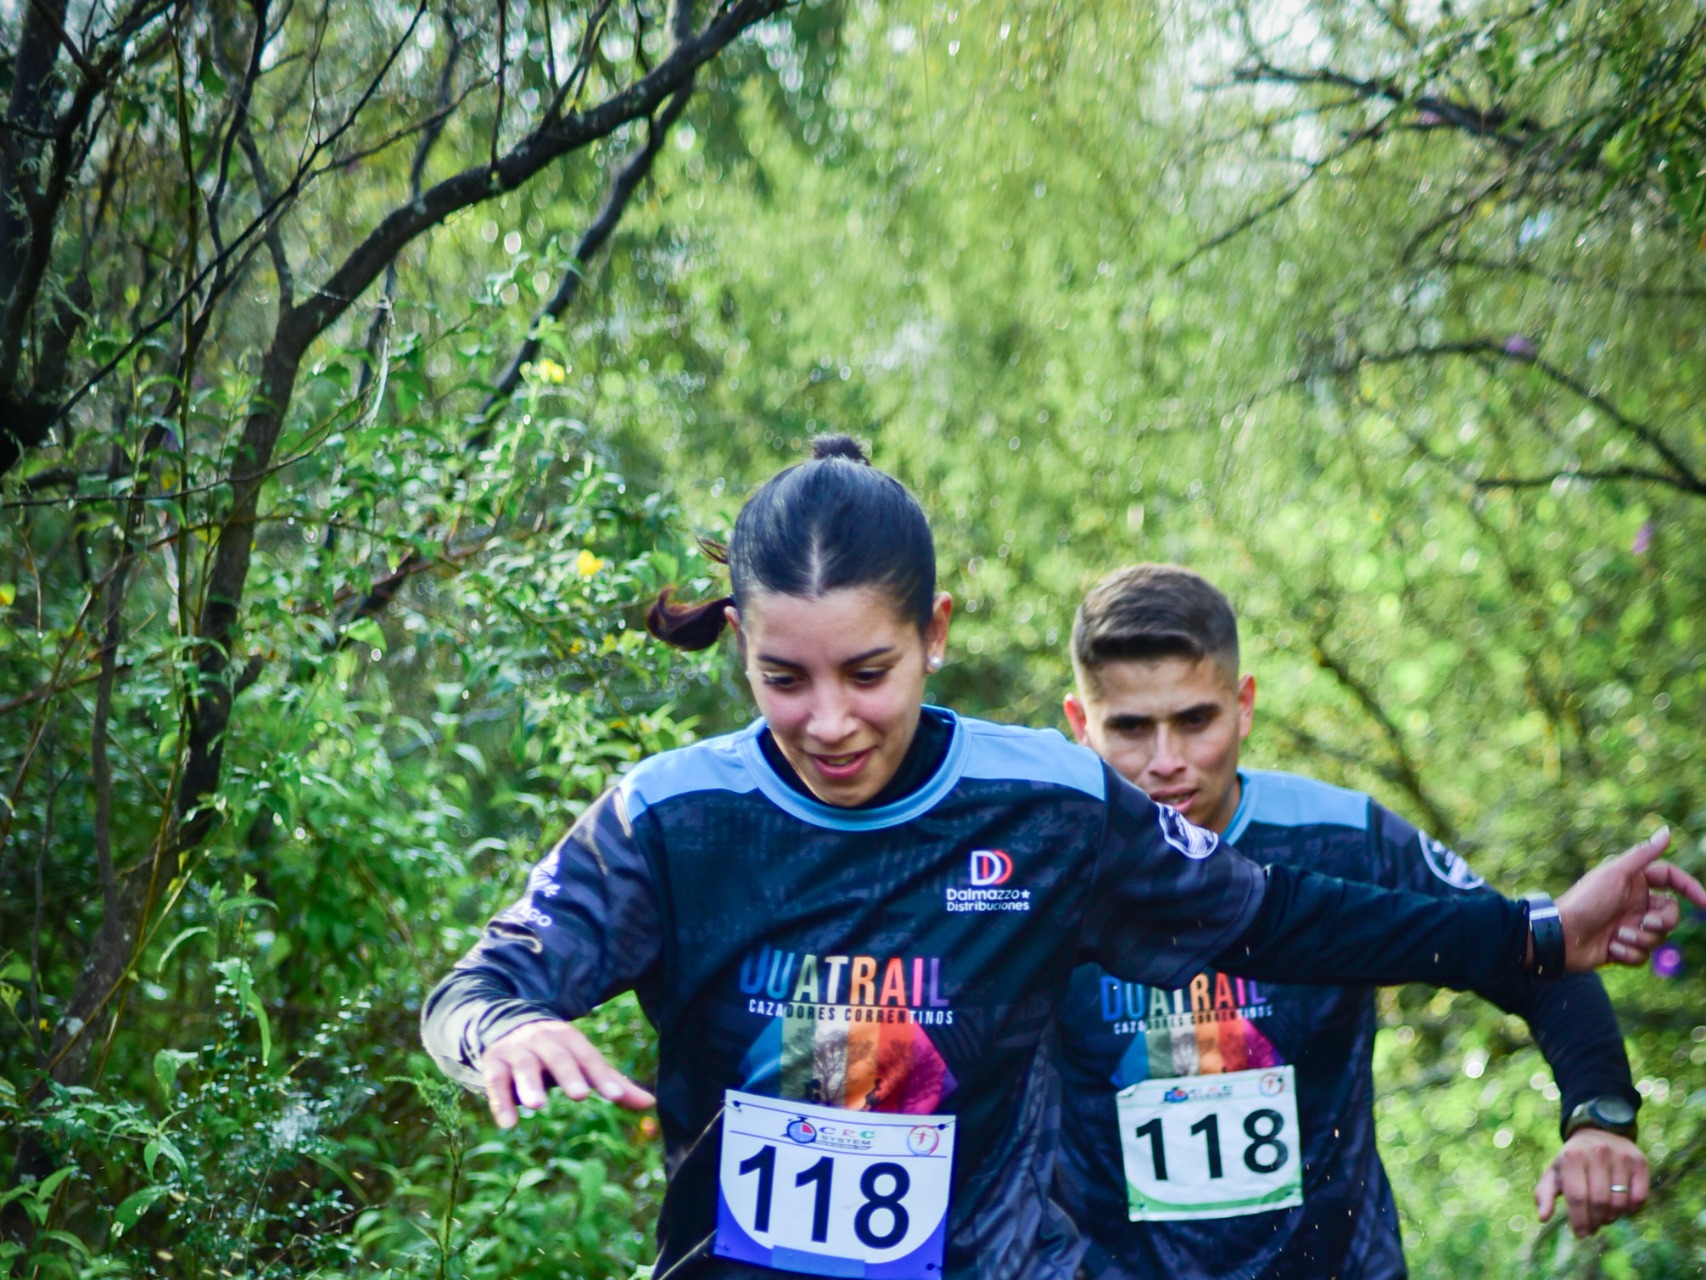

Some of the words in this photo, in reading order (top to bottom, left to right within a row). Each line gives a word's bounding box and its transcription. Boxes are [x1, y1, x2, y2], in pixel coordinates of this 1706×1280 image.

[946, 888, 1020, 901] Dalmazzo
[946, 900, 1030, 912] Distribuciones
[740, 944, 949, 1008] DUATRAIL
[748, 999, 836, 1021] CAZADORES
[844, 1007, 954, 1025] CORRENTINOS
[820, 1135, 872, 1145] SYSTEM
[1135, 1108, 1289, 1181] 118
[739, 1144, 911, 1250] 118
